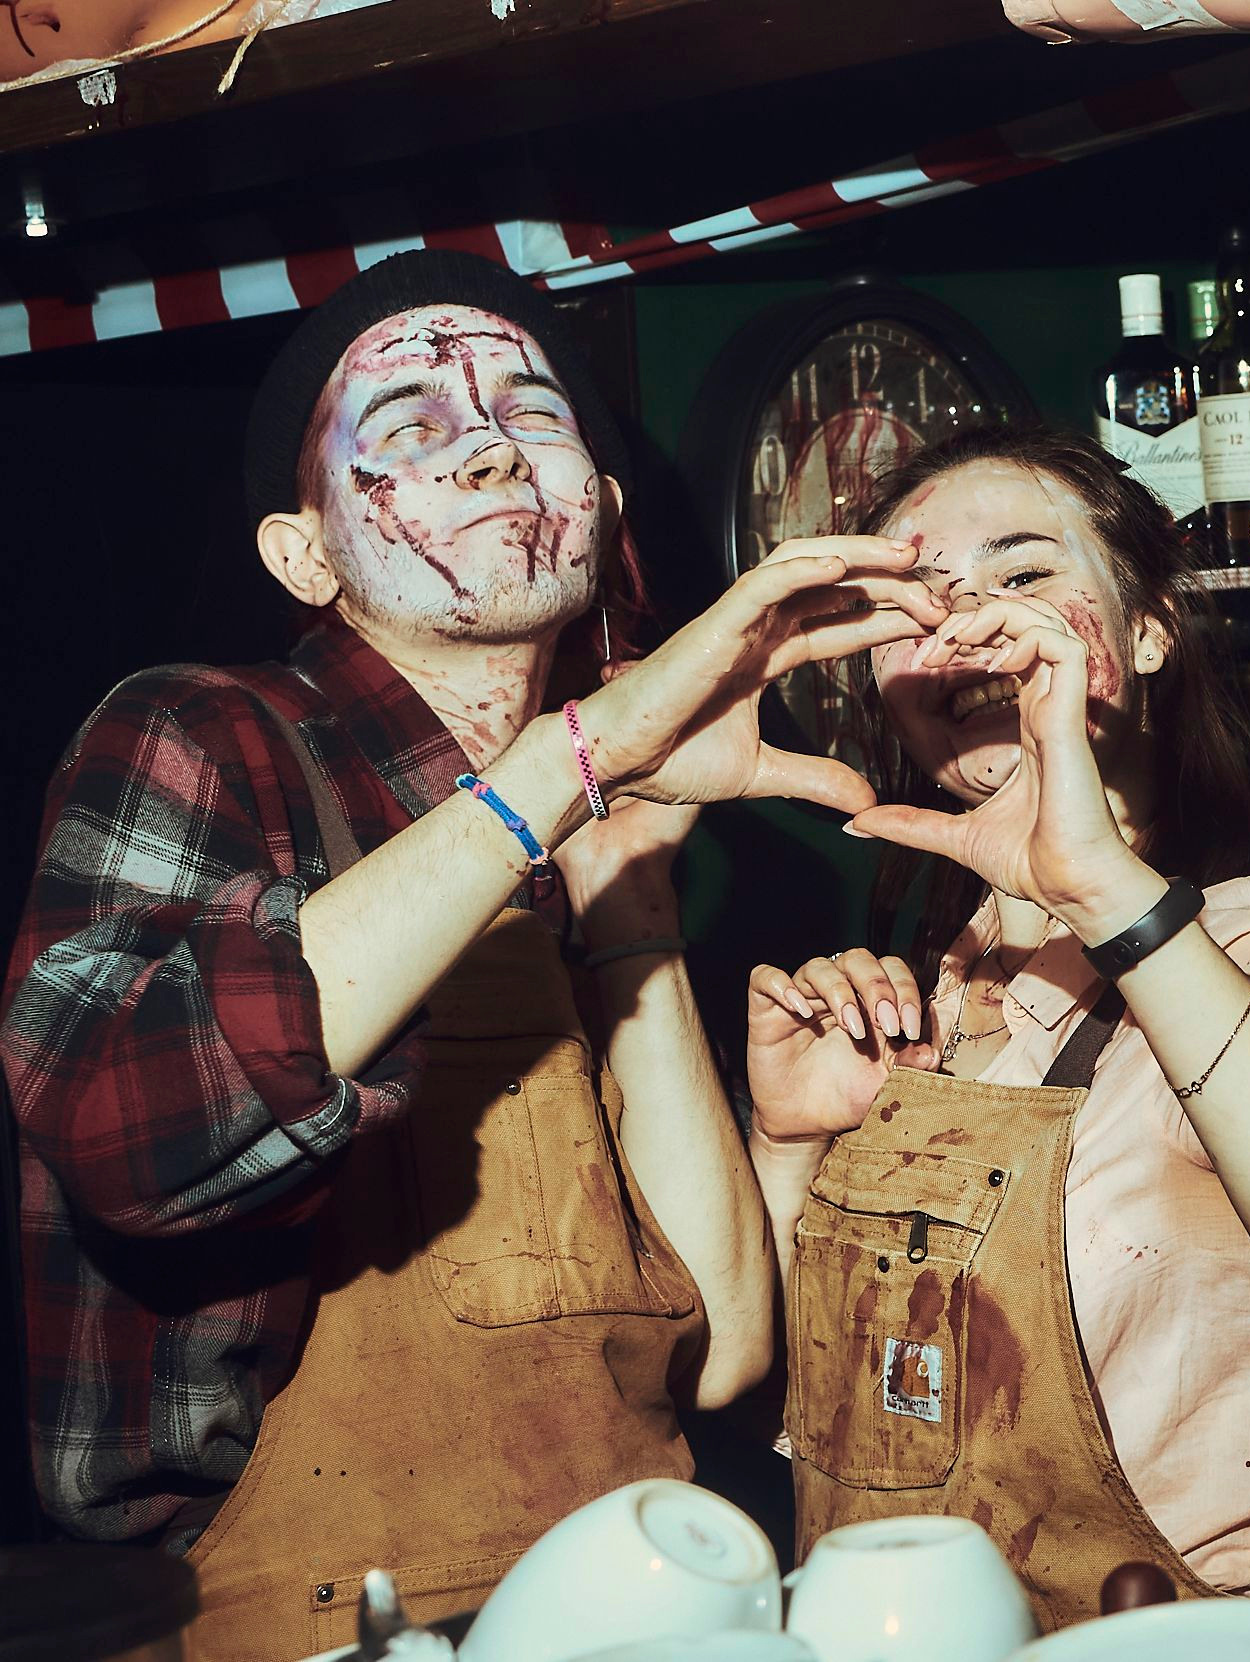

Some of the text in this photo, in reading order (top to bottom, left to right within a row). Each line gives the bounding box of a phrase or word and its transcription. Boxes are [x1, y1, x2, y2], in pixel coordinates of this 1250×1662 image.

[849, 343, 884, 403] 12
[791, 363, 819, 423] 11
[1203, 410, 1243, 427] CAOL
[1229, 434, 1243, 445] 12
